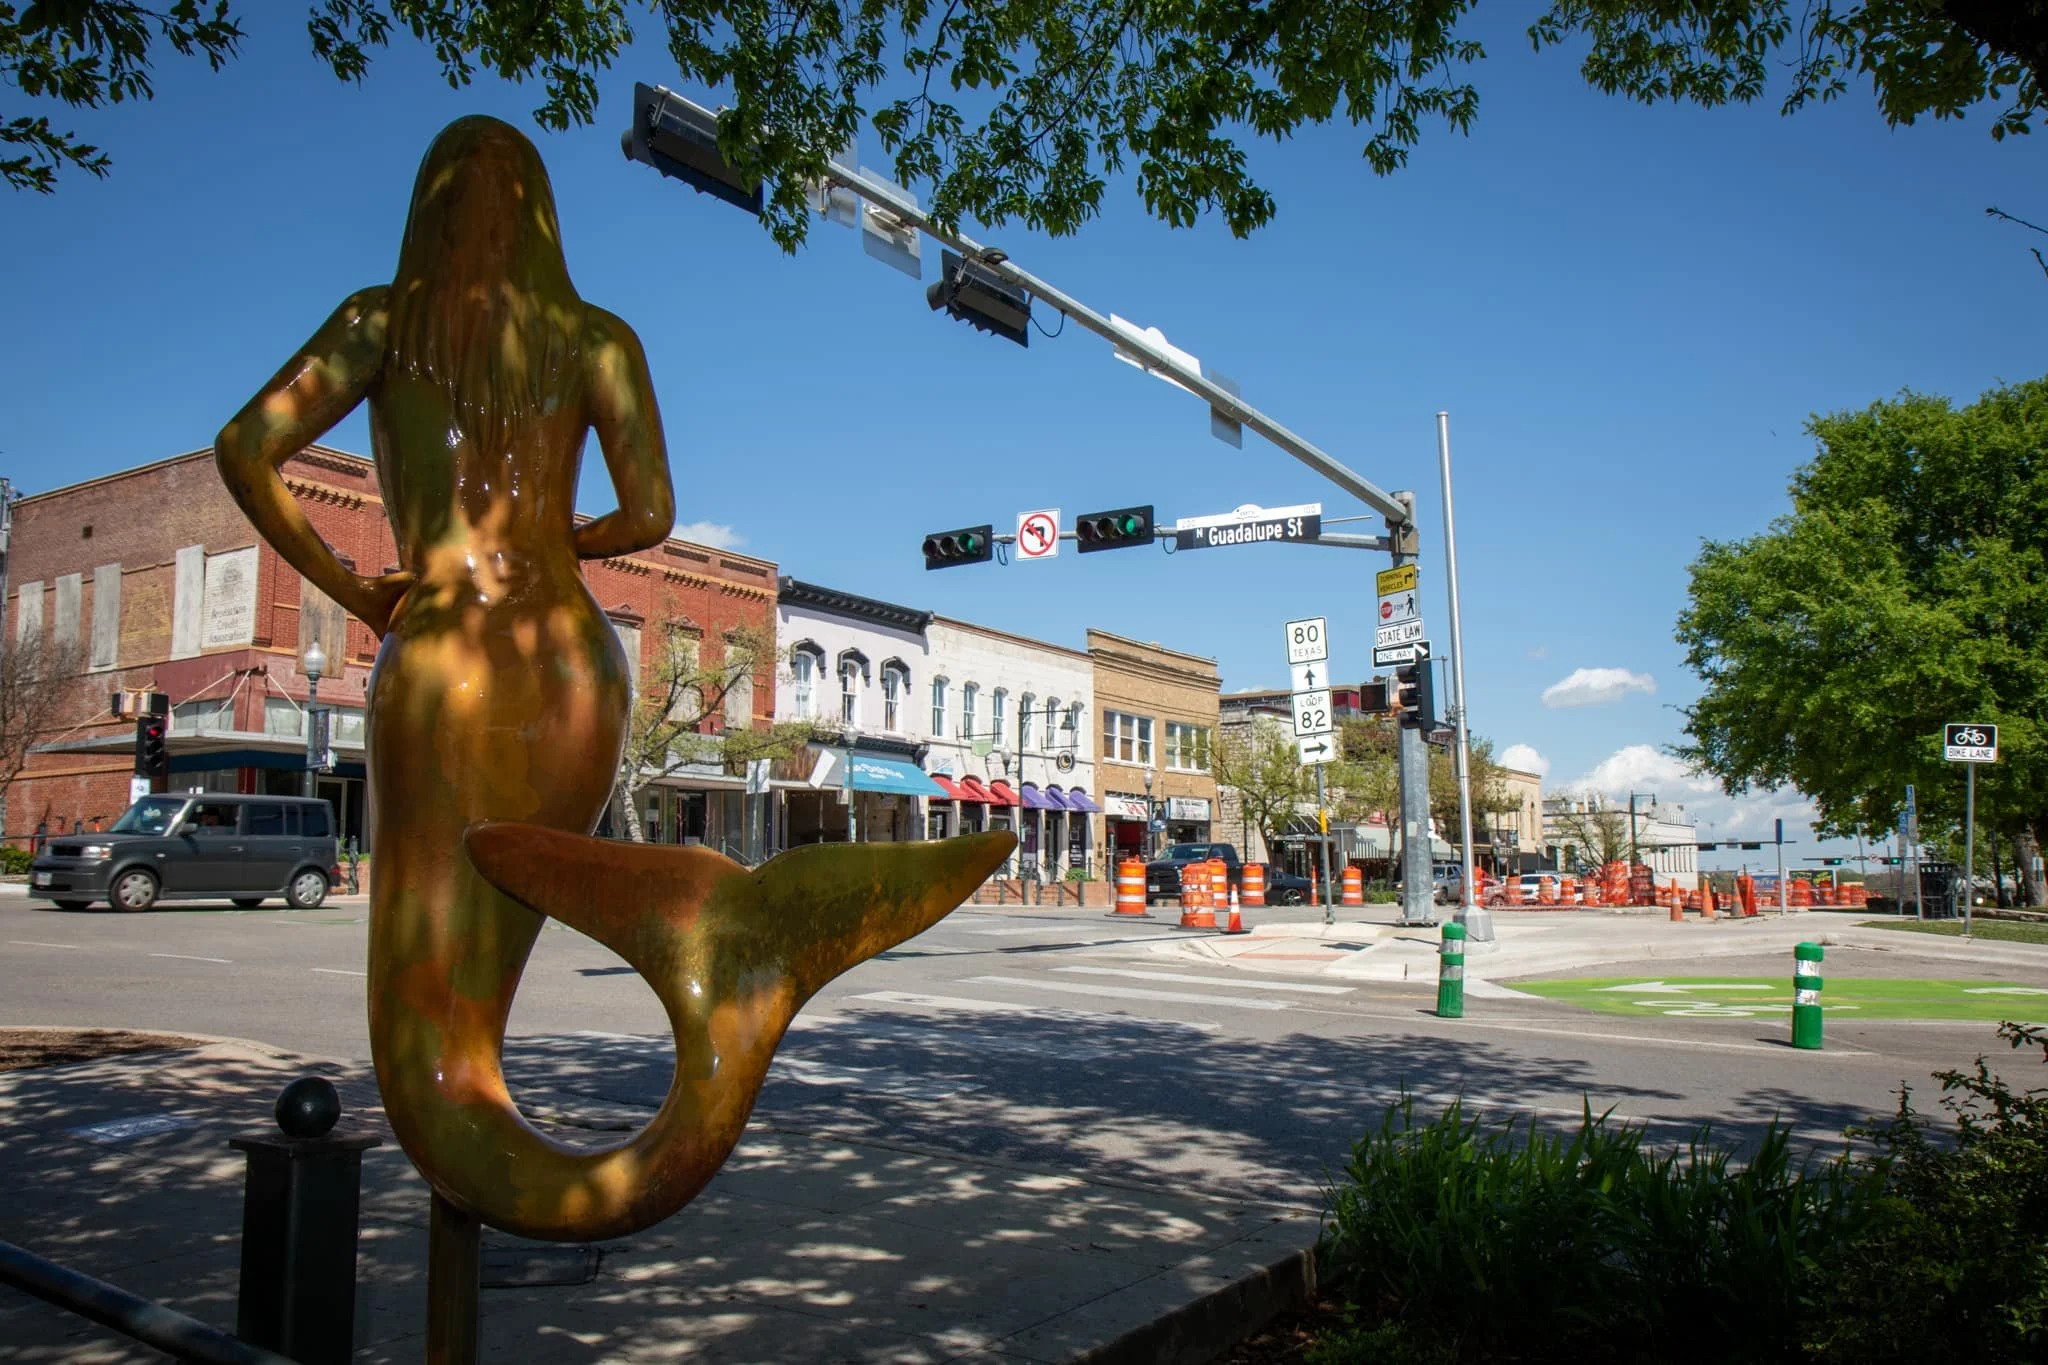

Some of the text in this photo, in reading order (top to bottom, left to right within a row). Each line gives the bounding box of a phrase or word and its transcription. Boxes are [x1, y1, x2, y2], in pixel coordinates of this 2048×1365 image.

[1196, 517, 1303, 545] N Guadalupe St
[1380, 582, 1404, 593] VEHICLES
[1294, 625, 1318, 644] 80
[1378, 626, 1420, 644] STATE LAW
[1293, 646, 1322, 657] TEXAS
[1378, 650, 1412, 661] ONE WAY
[1300, 696, 1324, 707] LOOP
[1302, 710, 1326, 729] 82
[1949, 748, 1992, 758] BIKE LANE
